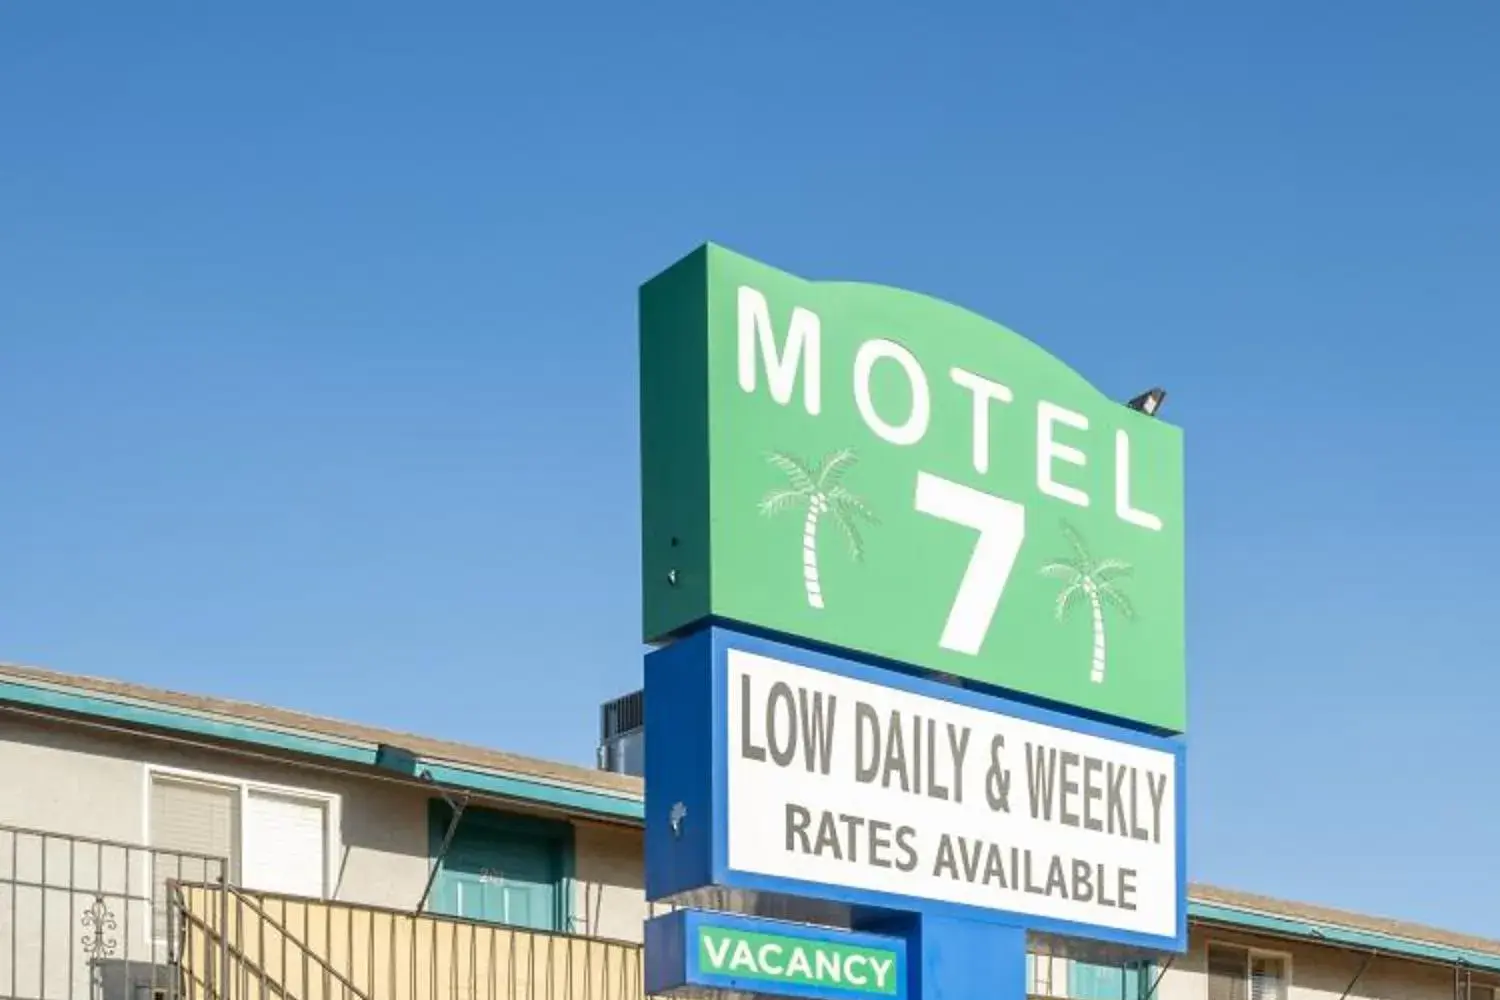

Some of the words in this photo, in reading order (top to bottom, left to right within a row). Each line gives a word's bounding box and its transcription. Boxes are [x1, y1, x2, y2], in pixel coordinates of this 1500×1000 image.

[737, 285, 1163, 531] MOTEL
[914, 469, 1025, 656] 7
[740, 673, 837, 776] LOW
[854, 701, 972, 803] DAILY
[985, 734, 1010, 813] &
[1024, 742, 1168, 844] WEEKLY
[785, 803, 918, 872] RATES
[933, 833, 1137, 911] AVAILABLE
[703, 935, 894, 988] VACANCY
